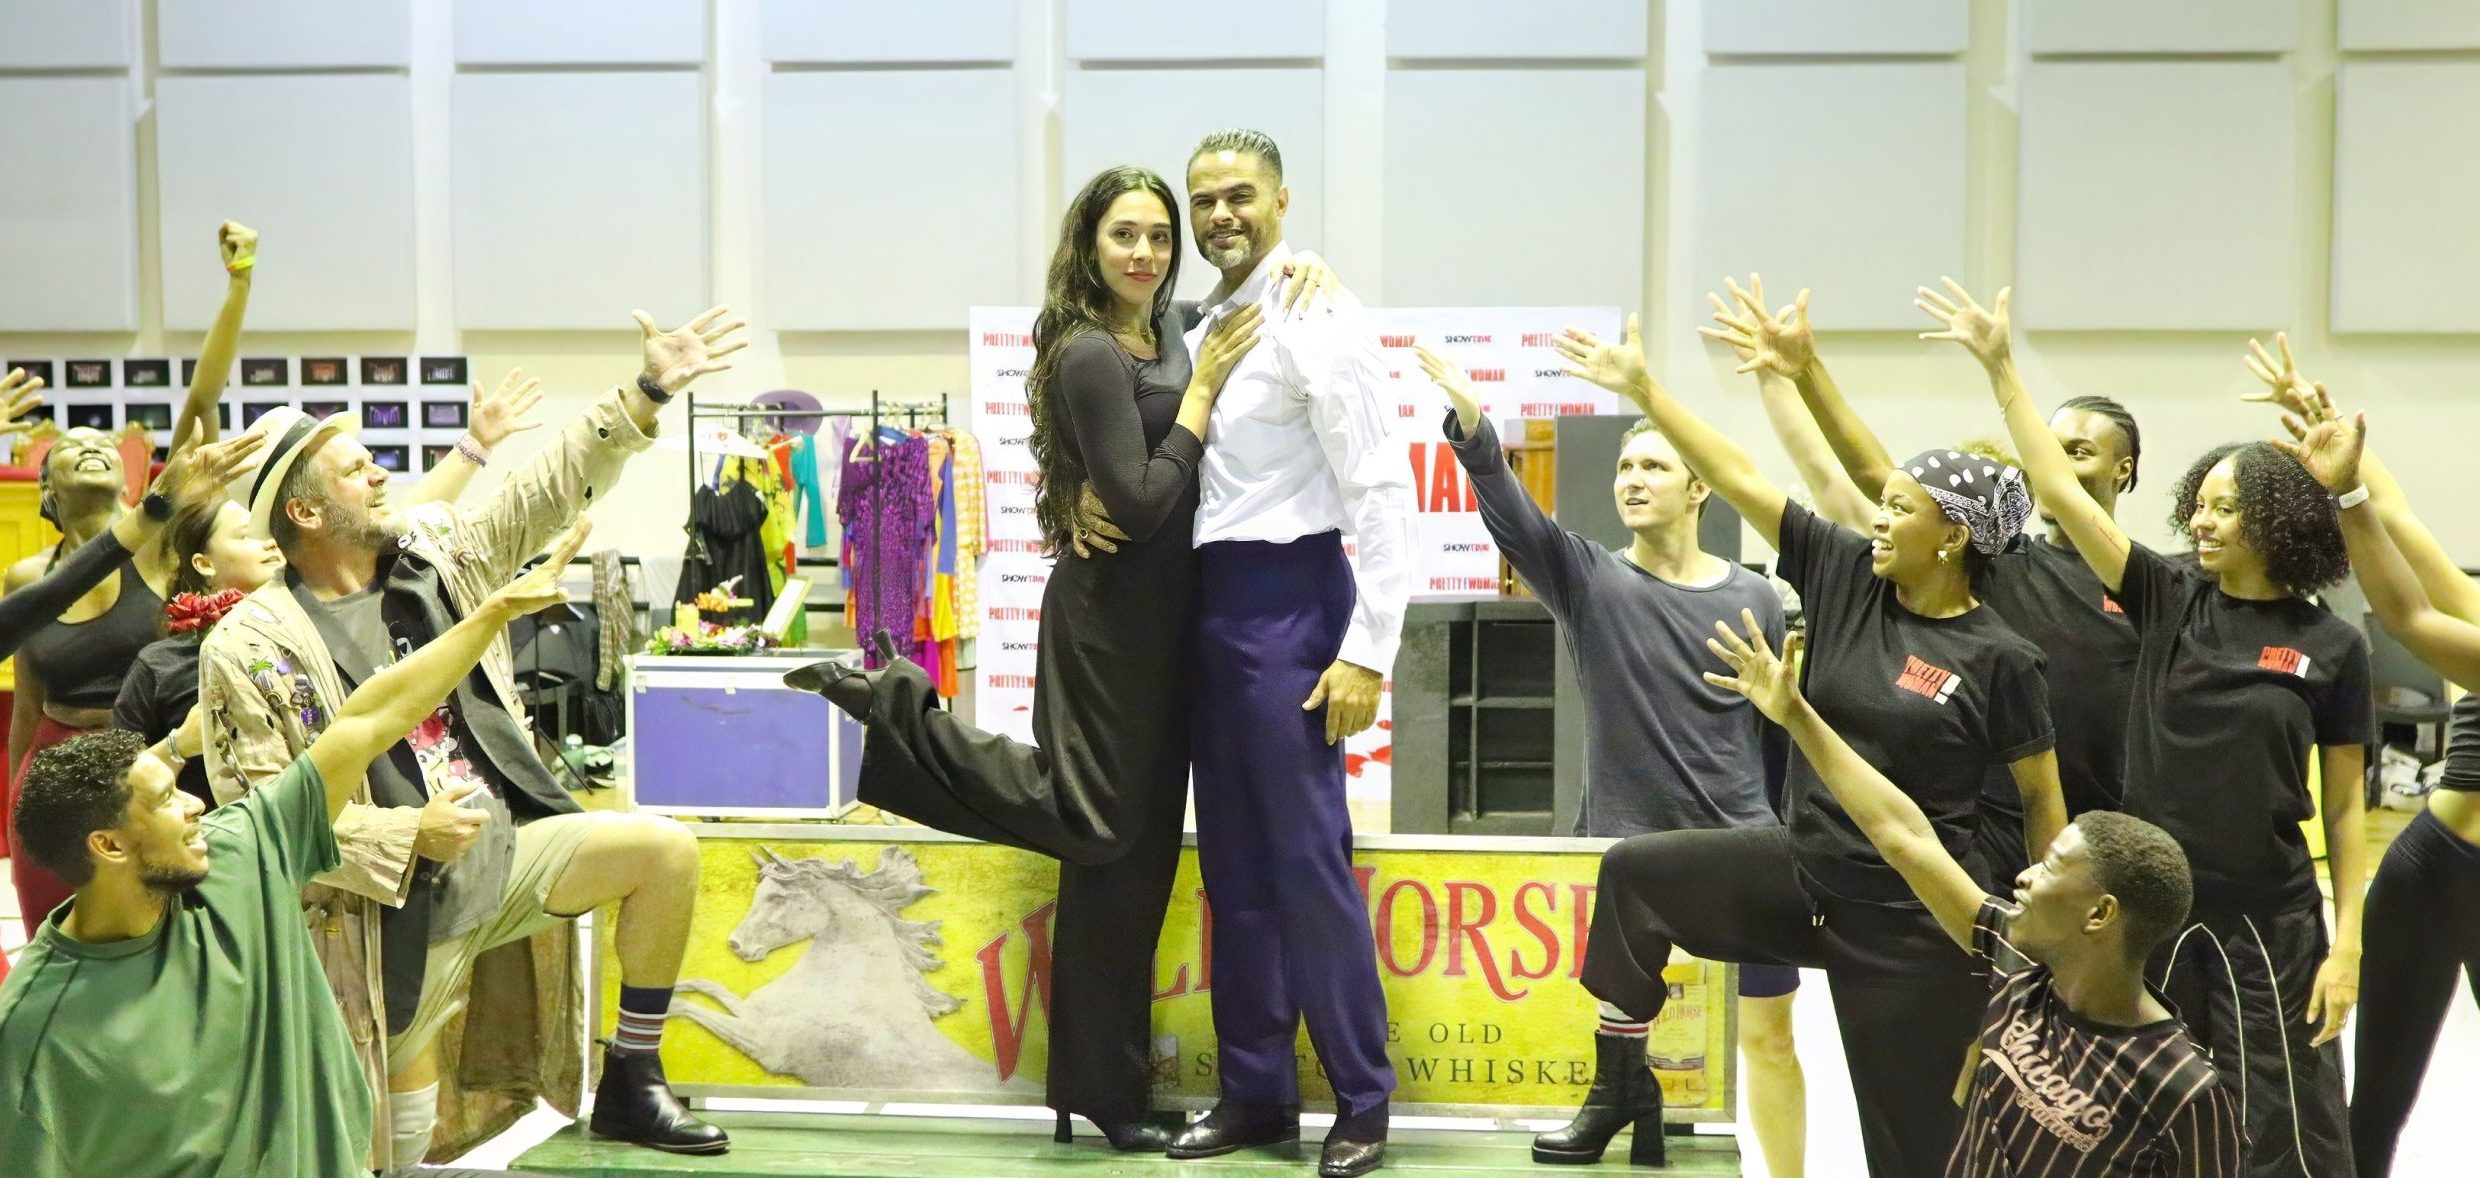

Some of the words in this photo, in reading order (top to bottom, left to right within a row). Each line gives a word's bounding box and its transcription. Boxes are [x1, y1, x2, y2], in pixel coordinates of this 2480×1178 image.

[1429, 1022, 1502, 1044] OLD
[1406, 1057, 1592, 1085] WHISKE
[2000, 1009, 2114, 1127] Chicago
